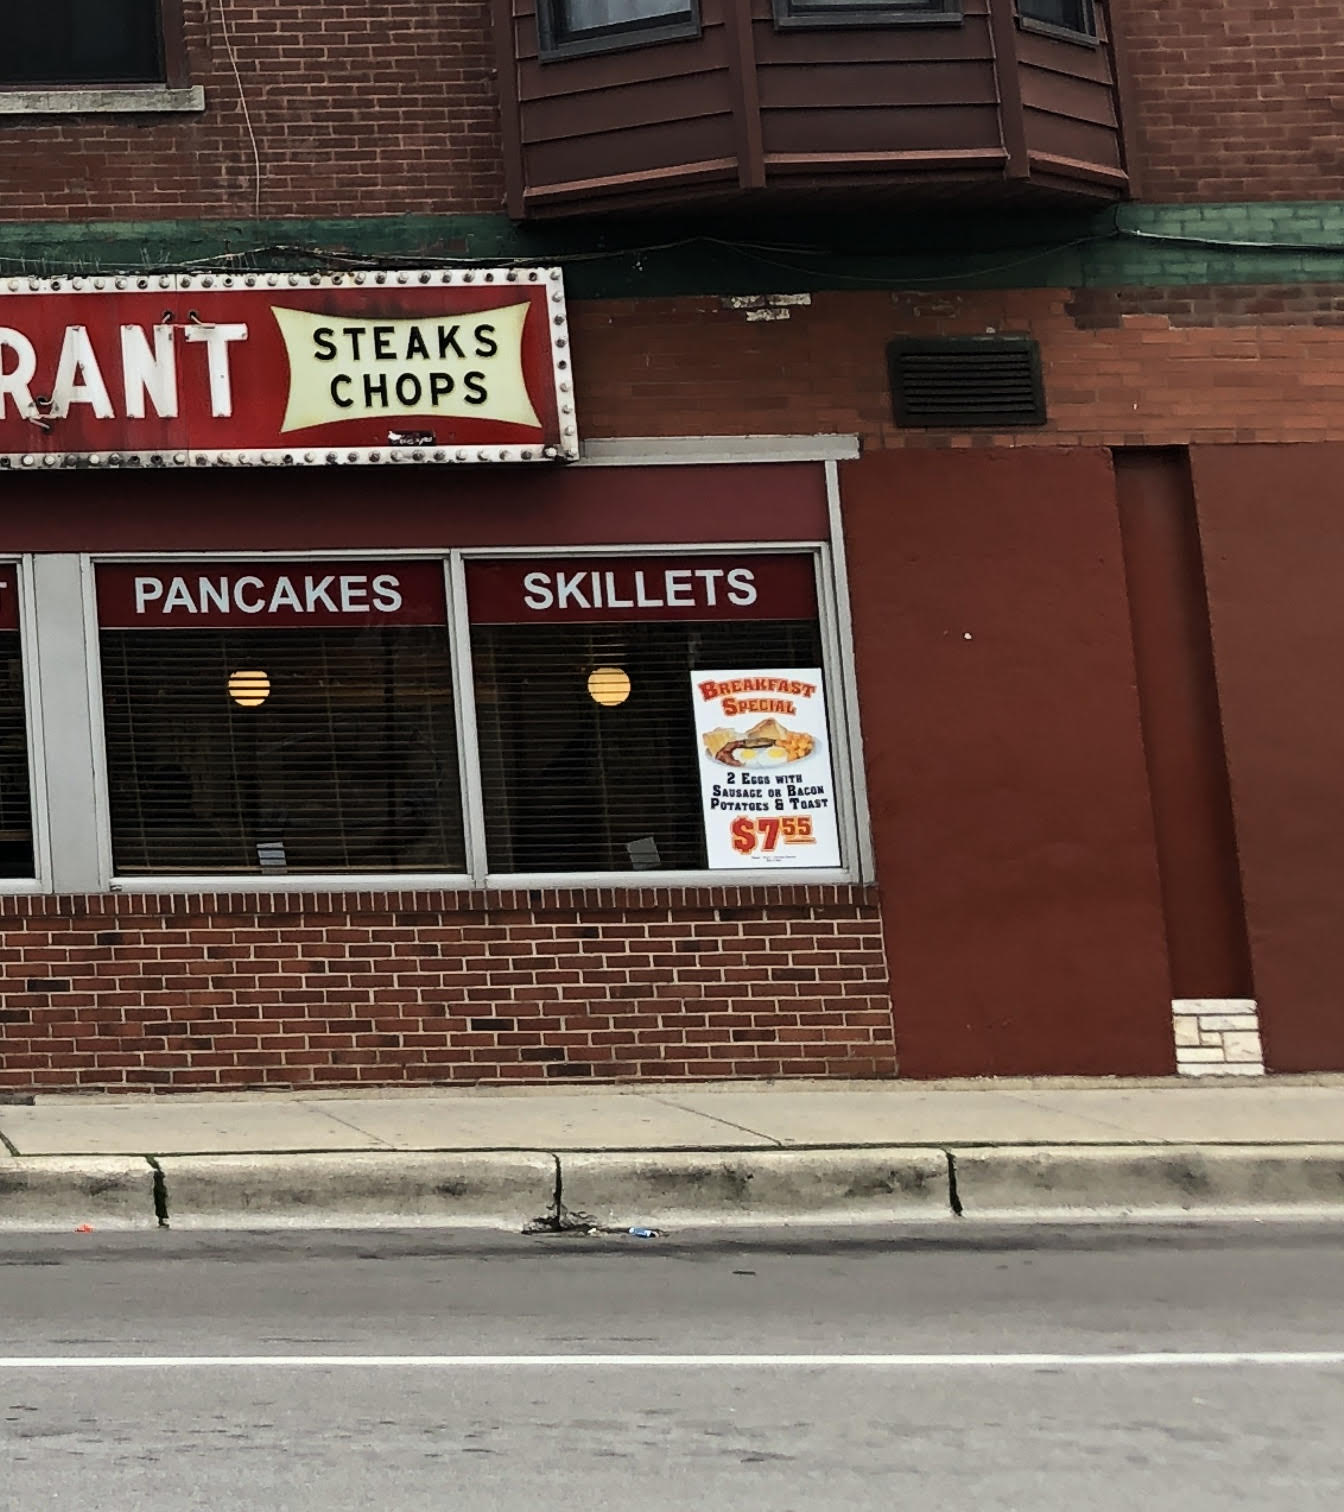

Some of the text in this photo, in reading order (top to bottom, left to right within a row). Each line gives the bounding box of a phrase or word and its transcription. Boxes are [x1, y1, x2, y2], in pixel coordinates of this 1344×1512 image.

[313, 324, 499, 361] STEAKS
[329, 370, 489, 407] CHOPS
[133, 574, 403, 615] PANCAKES
[523, 568, 758, 610] SKILLETS
[698, 677, 817, 702] BREAKFAST
[721, 697, 797, 716] SPECIAL
[727, 772, 736, 784] 2
[775, 798, 784, 811] &
